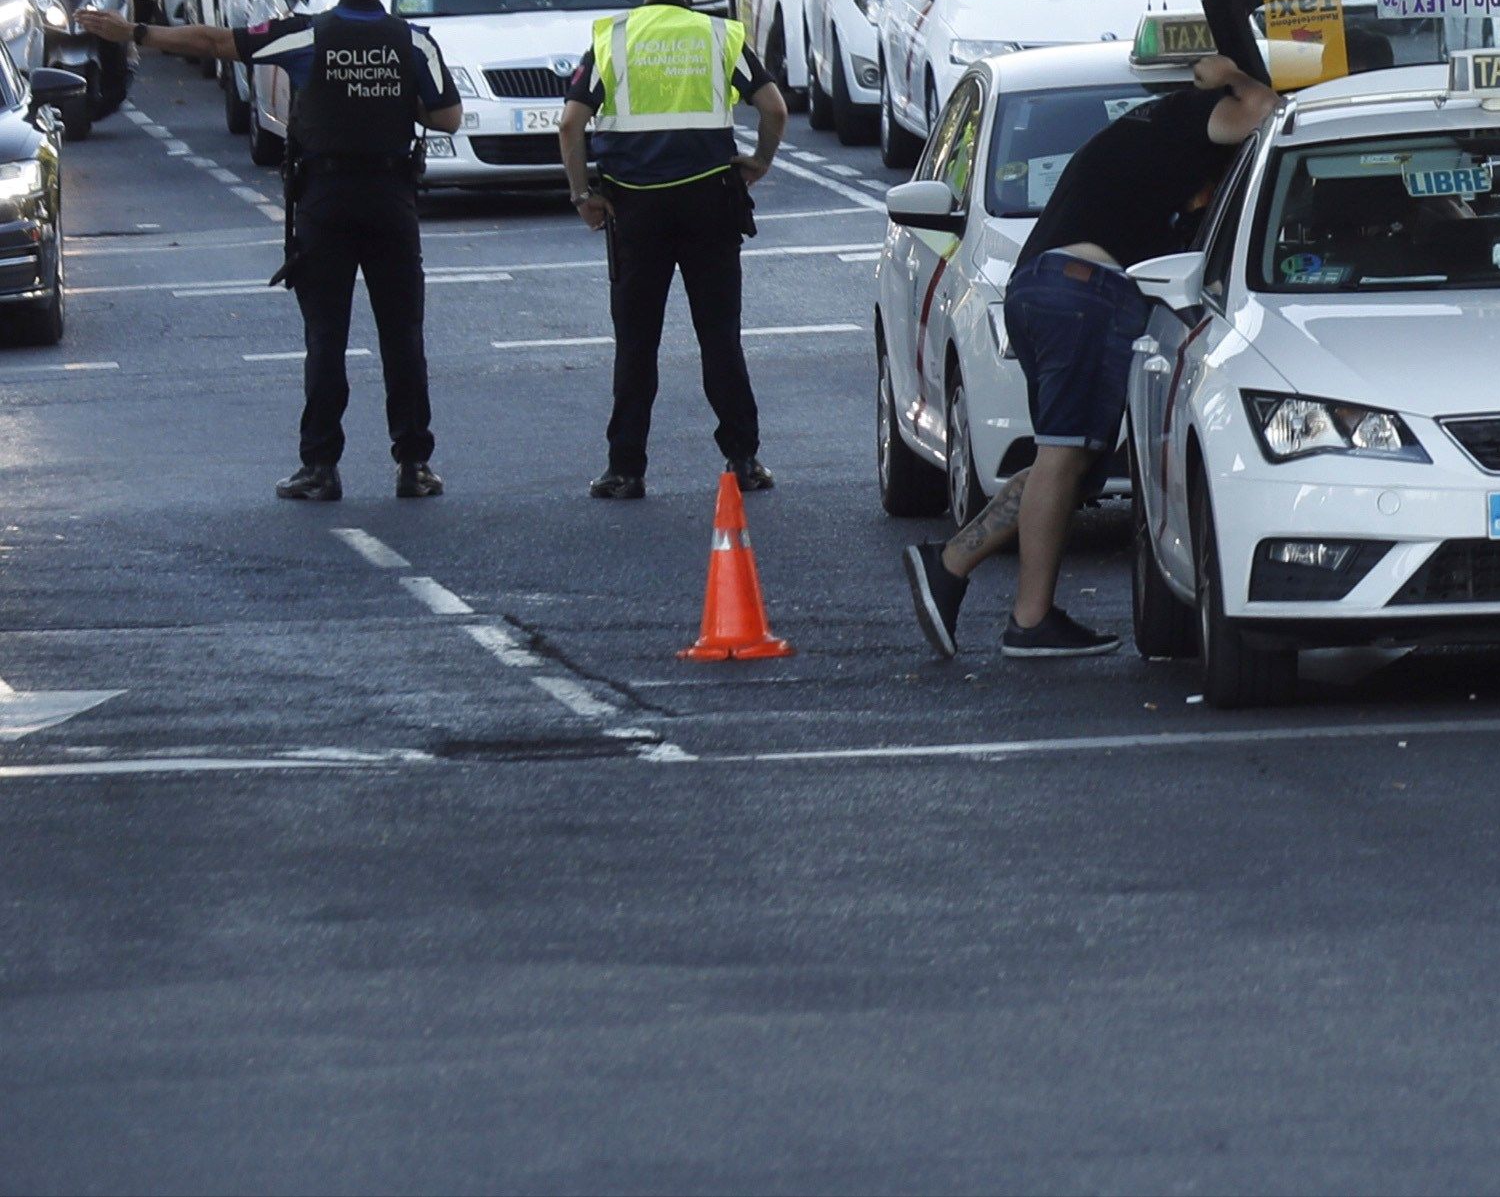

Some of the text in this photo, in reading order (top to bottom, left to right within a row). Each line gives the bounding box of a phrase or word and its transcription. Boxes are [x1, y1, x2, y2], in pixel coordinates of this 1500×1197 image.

[326, 45, 400, 66] POLICÍA
[326, 68, 401, 81] MUNICIPAL
[348, 82, 401, 97] Madrid
[1409, 167, 1490, 195] LIBRE
